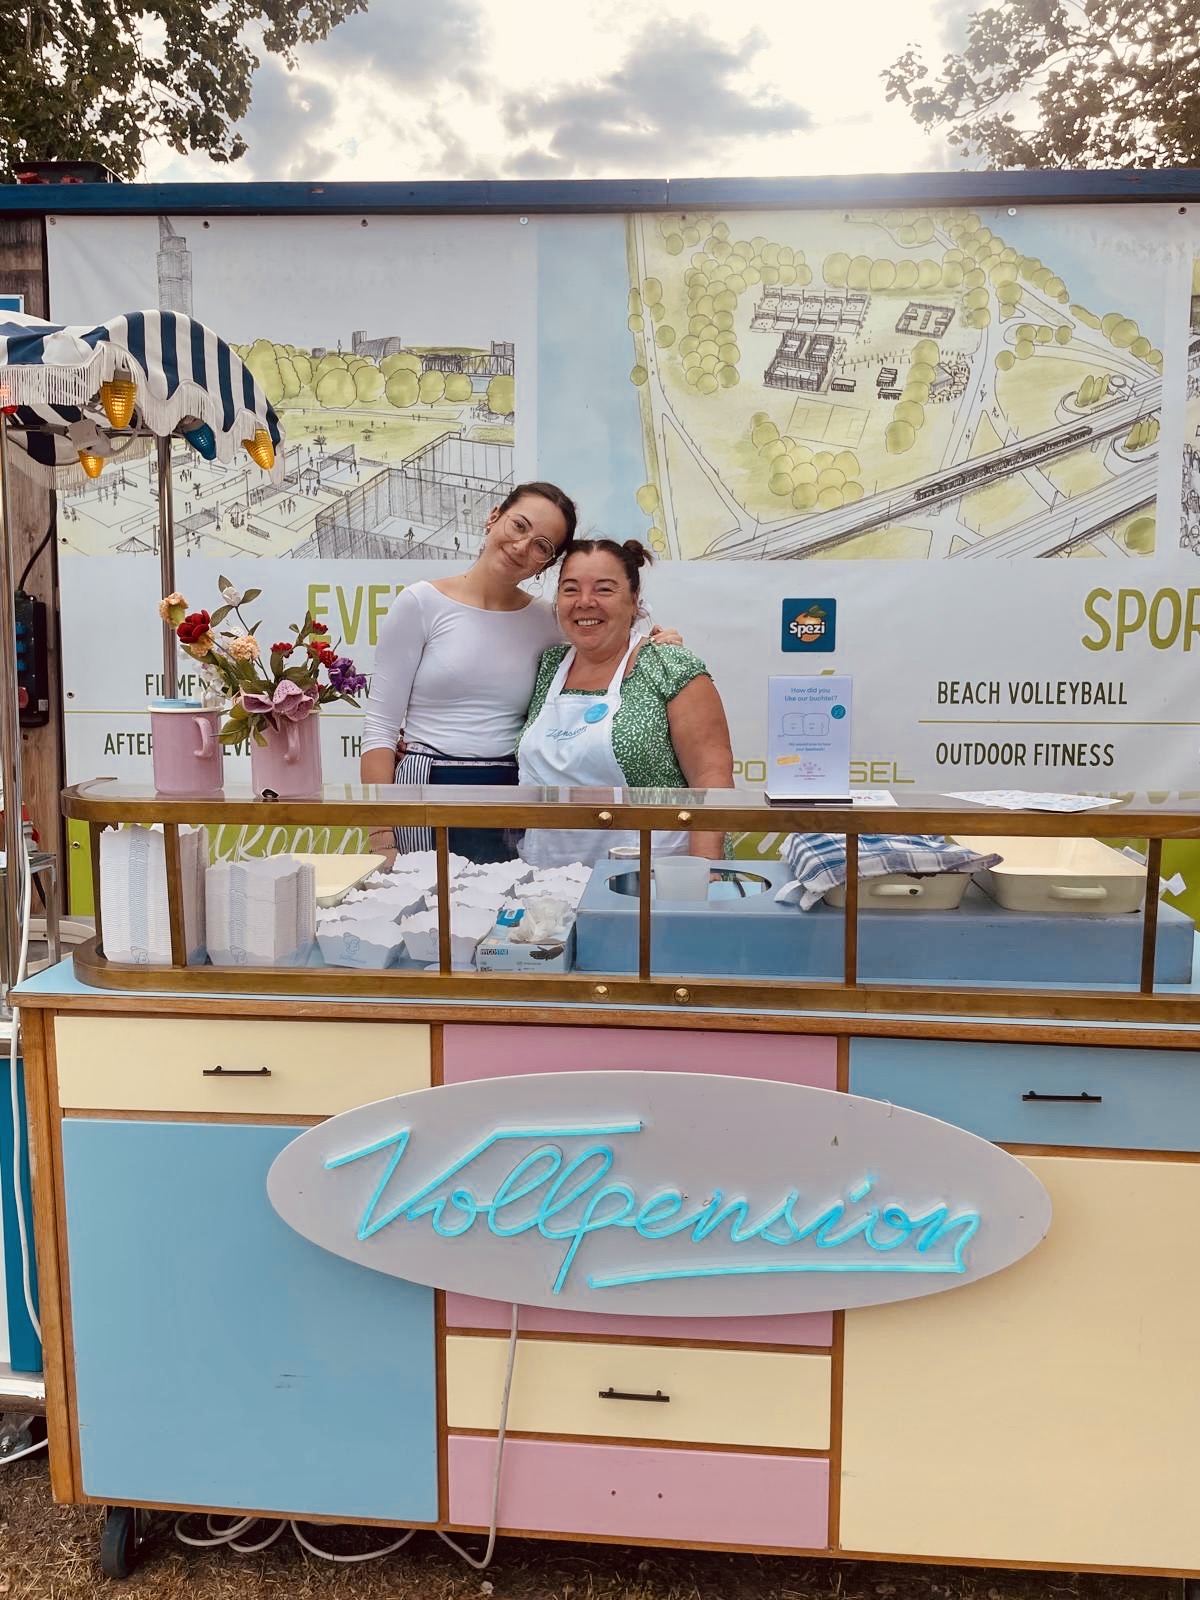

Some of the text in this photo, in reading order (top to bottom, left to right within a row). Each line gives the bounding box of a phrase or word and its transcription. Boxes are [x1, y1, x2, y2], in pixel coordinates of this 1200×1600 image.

[308, 585, 405, 646] EVE
[789, 621, 826, 638] Spezi
[937, 681, 1128, 705] BEACH VOLLEYBALL
[936, 742, 1115, 767] OUTDOOR FITNESS
[323, 1120, 982, 1295] Vollpension
